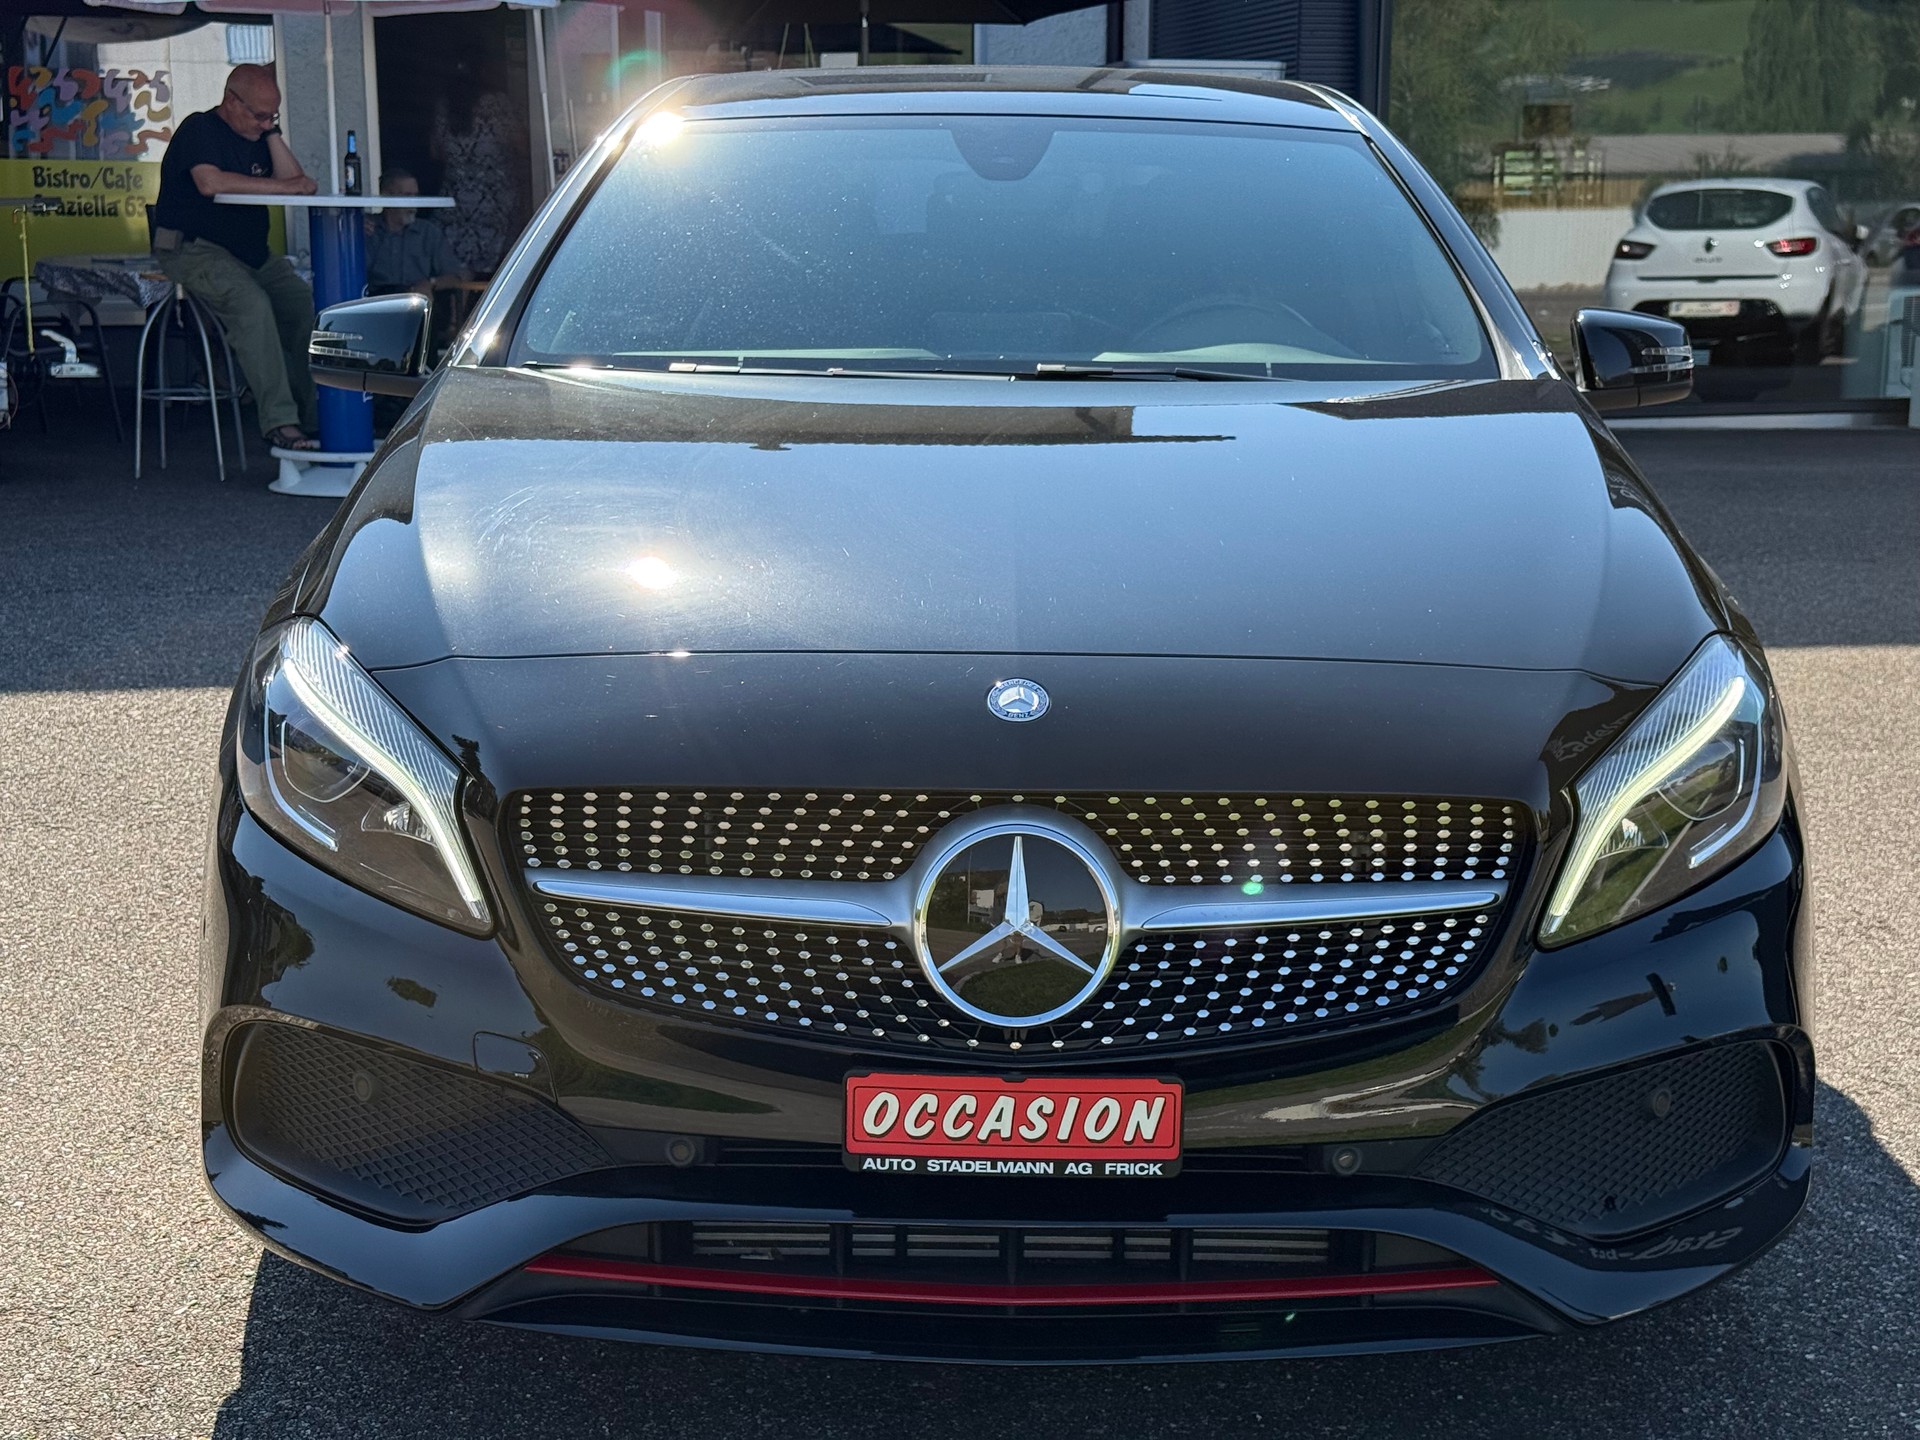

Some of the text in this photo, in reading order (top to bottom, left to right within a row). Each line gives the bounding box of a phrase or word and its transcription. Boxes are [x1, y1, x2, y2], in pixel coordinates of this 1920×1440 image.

[32, 166, 143, 191] Bistro/Cafe
[862, 1091, 1166, 1143] OCCASION
[862, 1157, 1163, 1176] AUTO STADELMANN AG FRICK
